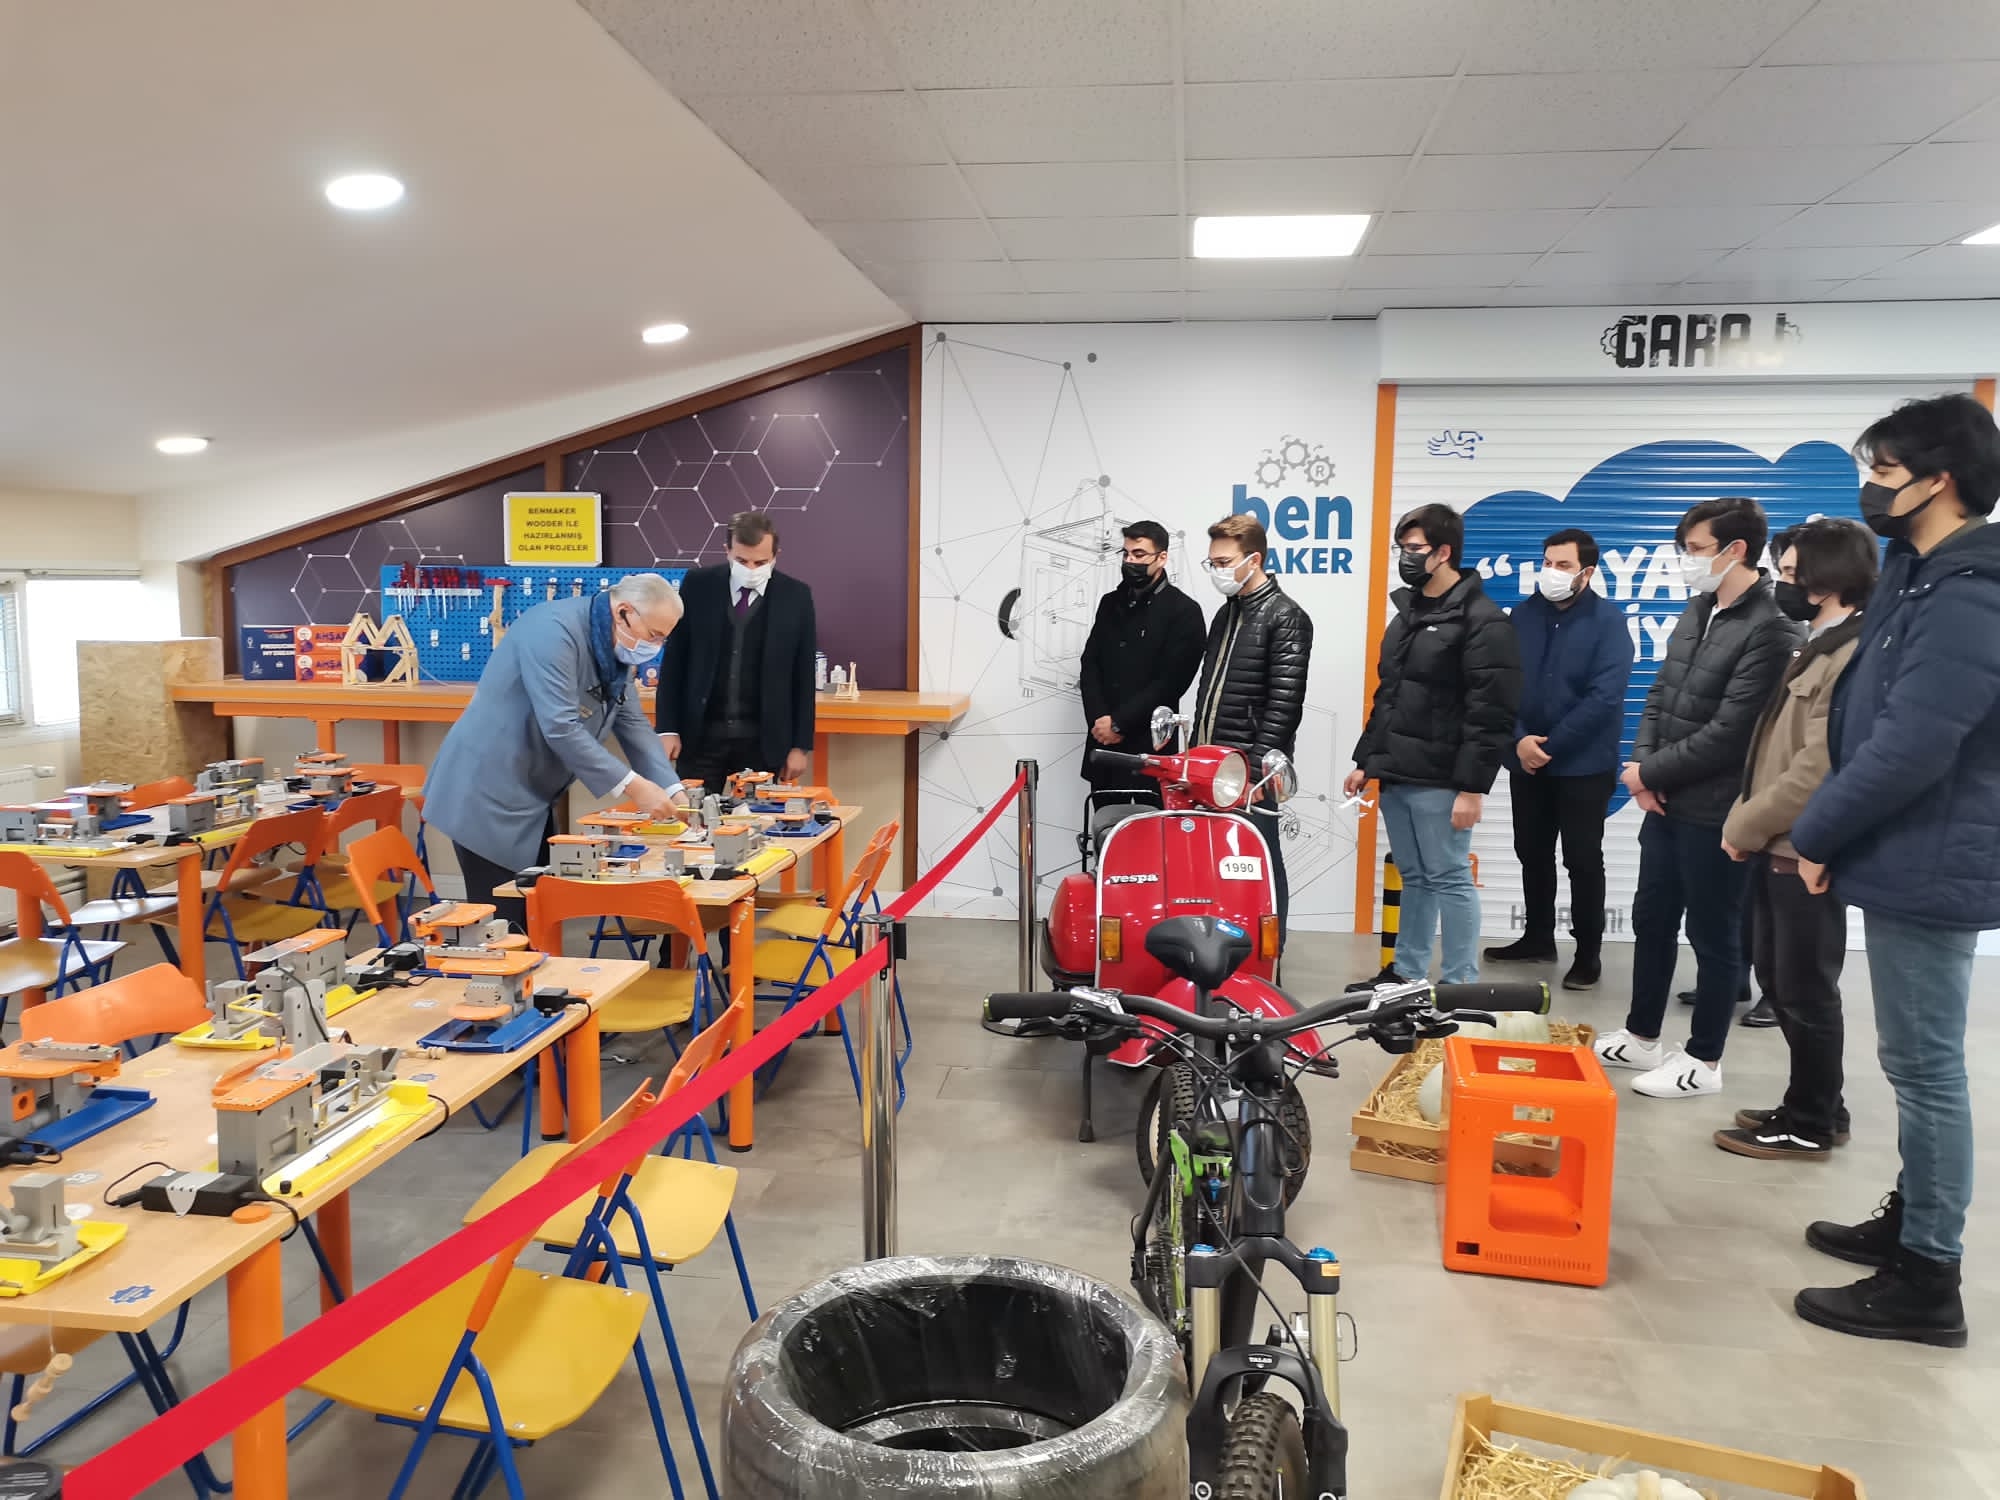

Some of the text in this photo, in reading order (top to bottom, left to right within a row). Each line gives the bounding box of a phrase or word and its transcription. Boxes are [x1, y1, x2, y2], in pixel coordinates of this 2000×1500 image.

[1232, 484, 1353, 541] ben
[565, 519, 579, 527] İLE
[523, 532, 582, 540] HAZIRLANMIŞ
[1263, 547, 1353, 574] AKER
[1225, 862, 1254, 873] 1990
[1105, 874, 1159, 884] vespa
